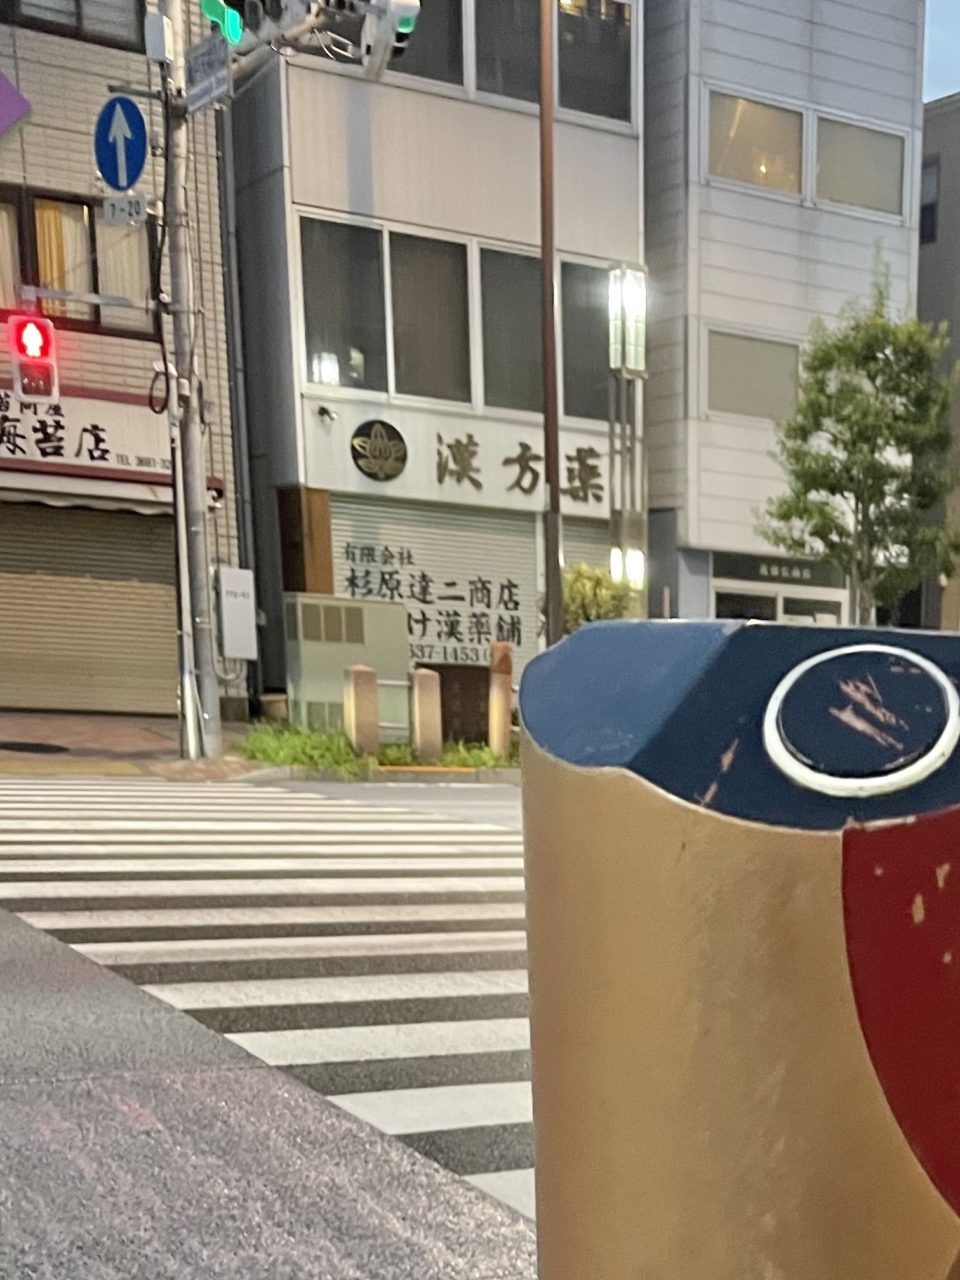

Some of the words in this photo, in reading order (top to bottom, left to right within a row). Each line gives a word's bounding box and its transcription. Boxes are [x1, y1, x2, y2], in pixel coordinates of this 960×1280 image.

[437, 432, 604, 502] 漢方薬
[343, 541, 415, 566] 有限会社
[345, 567, 520, 612] 杉原達二商店
